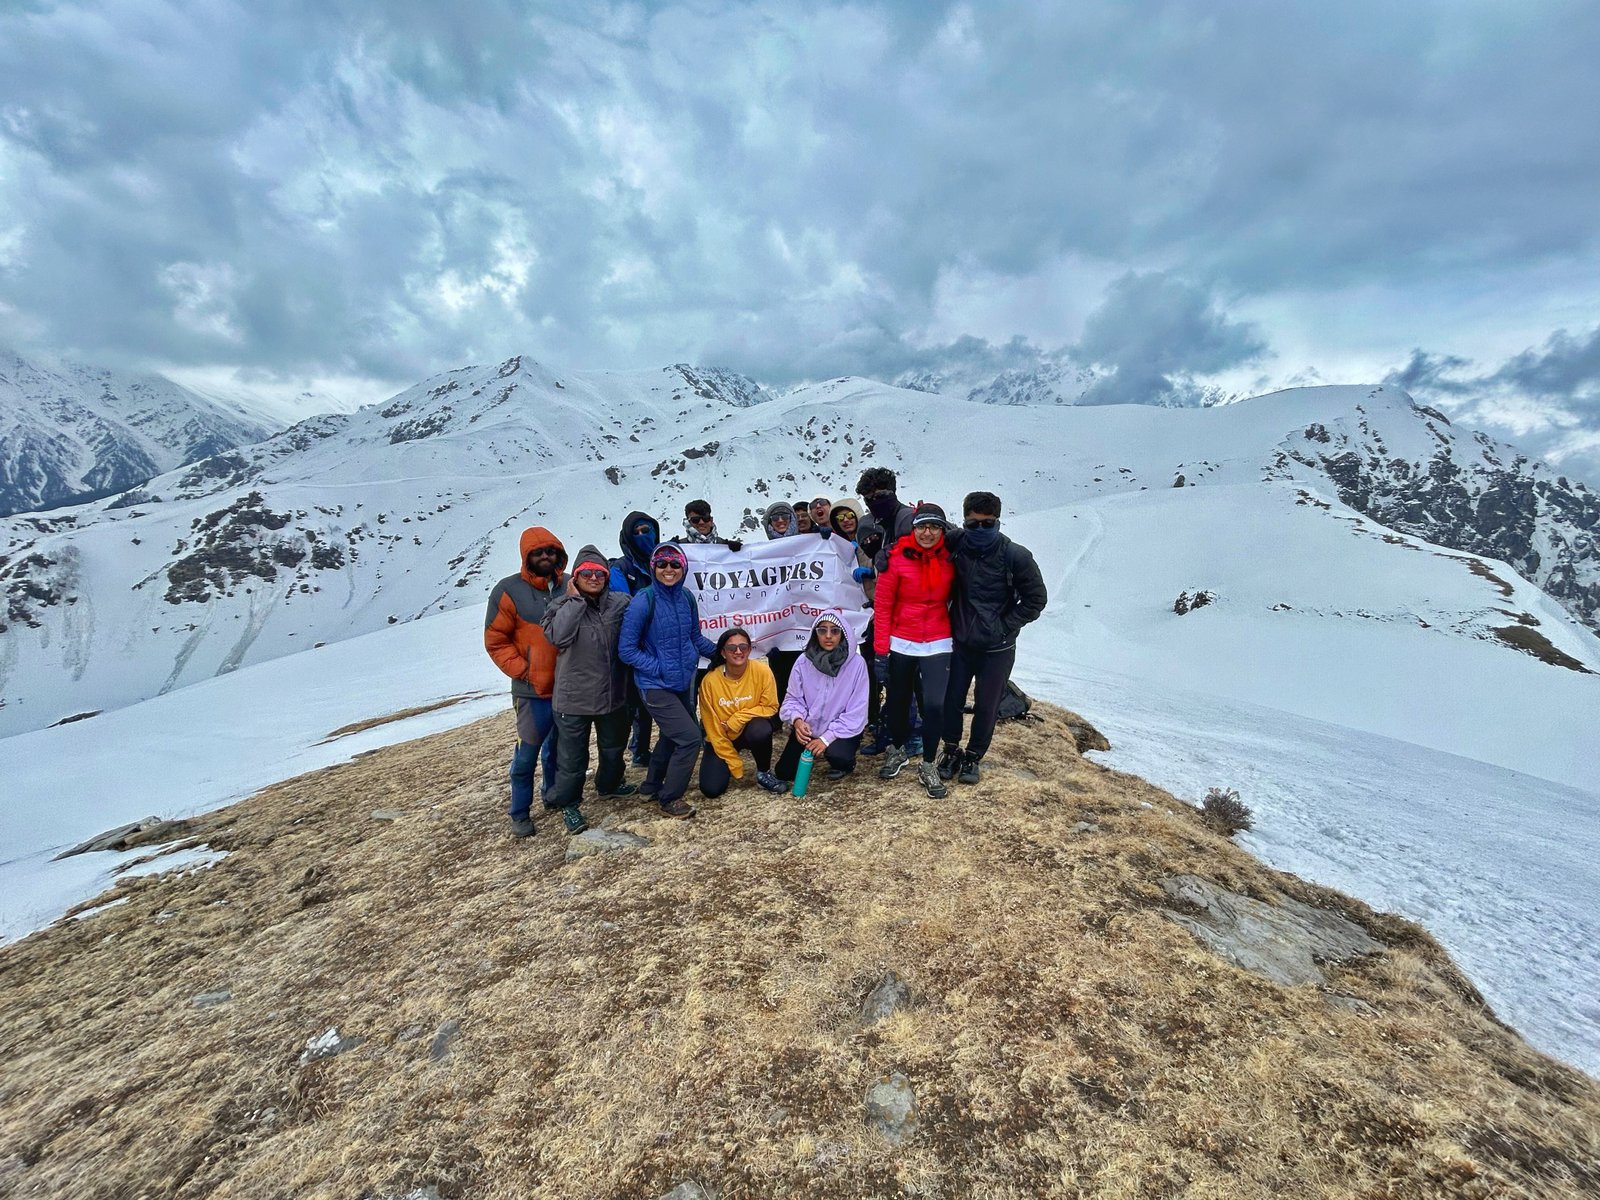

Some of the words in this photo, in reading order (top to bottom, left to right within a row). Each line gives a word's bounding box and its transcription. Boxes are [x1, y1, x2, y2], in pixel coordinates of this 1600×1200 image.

[693, 560, 824, 591] VOYAGERS
[697, 583, 820, 602] Adventure
[699, 615, 728, 630] nali
[733, 605, 796, 627] Summer
[799, 603, 843, 617] Ca
